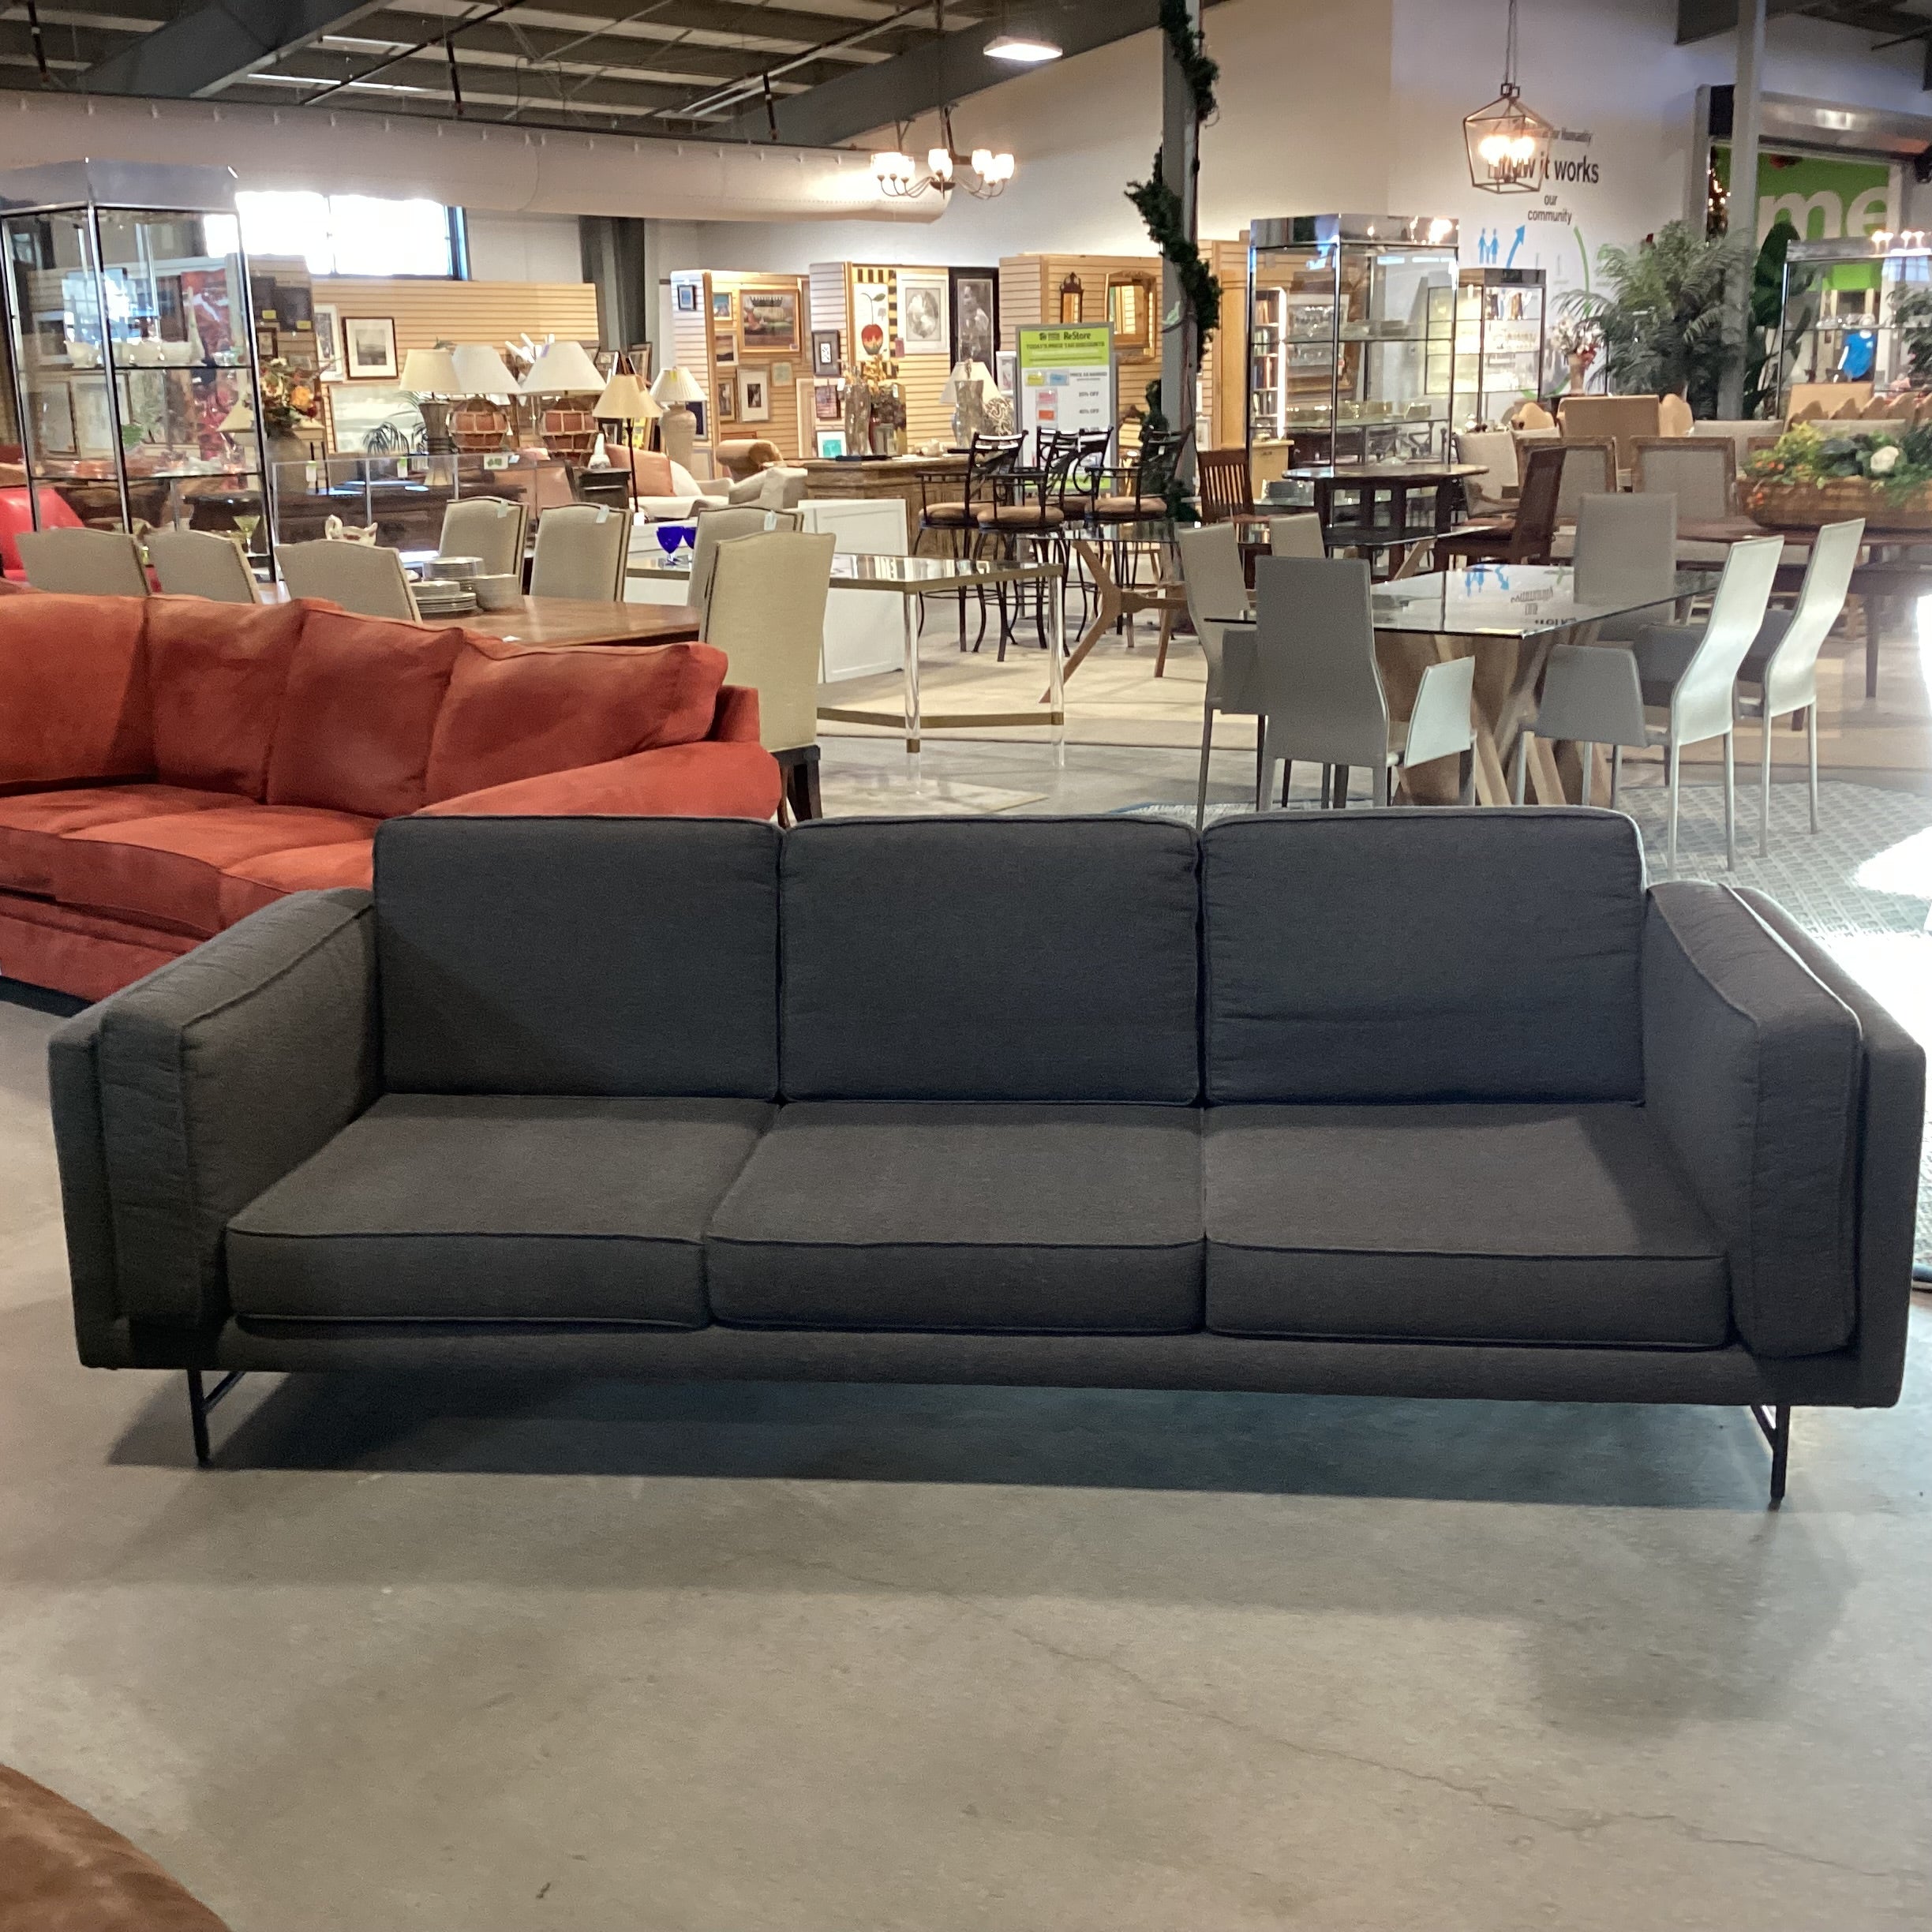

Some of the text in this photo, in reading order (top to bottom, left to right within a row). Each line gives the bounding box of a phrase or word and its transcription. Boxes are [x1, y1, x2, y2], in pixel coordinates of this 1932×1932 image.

[1555, 155, 1599, 183] works
[1544, 195, 1558, 205] our
[1527, 209, 1572, 225] community
[1063, 331, 1091, 340] ReStore
